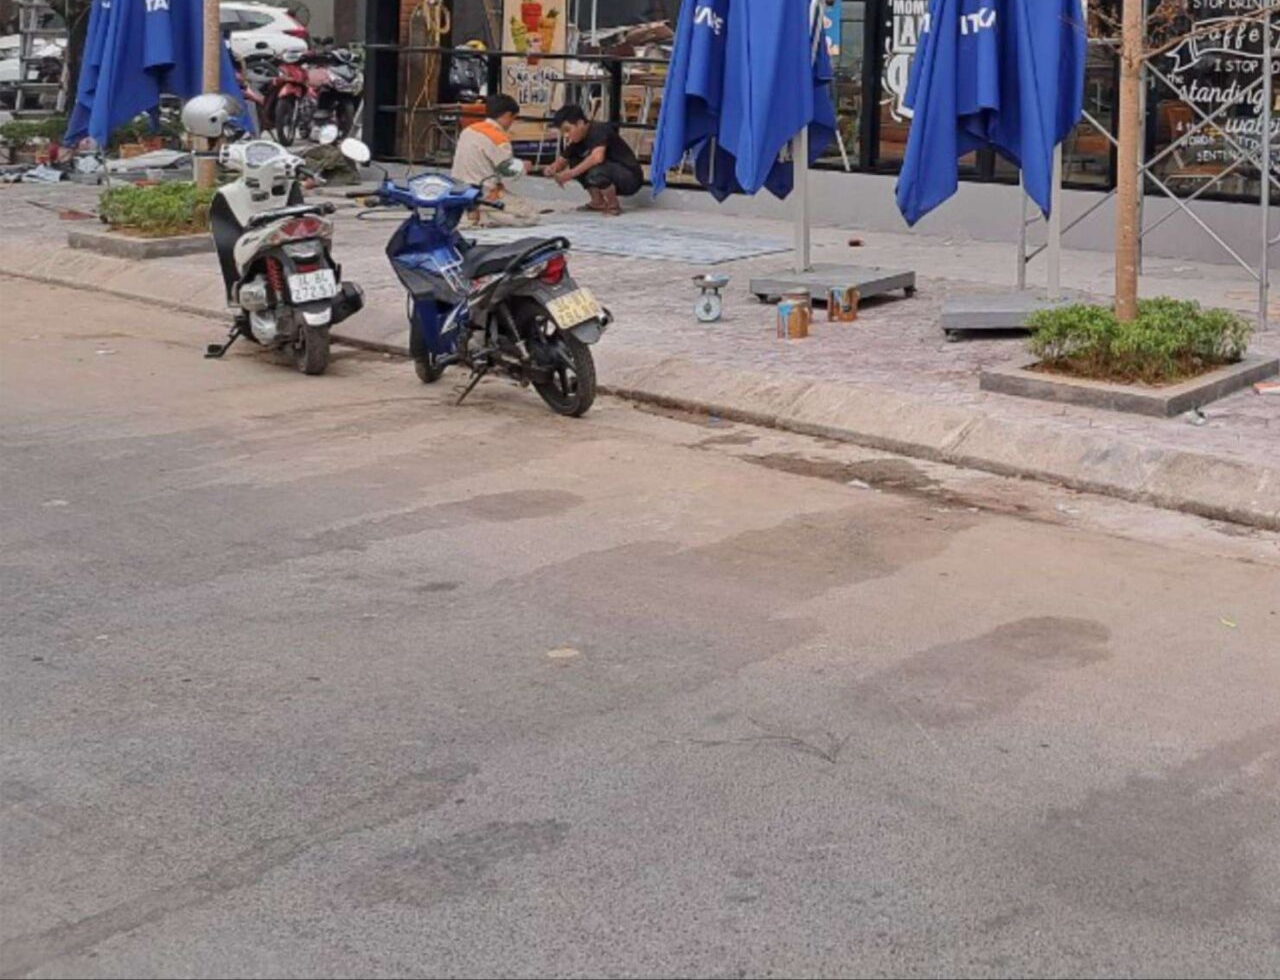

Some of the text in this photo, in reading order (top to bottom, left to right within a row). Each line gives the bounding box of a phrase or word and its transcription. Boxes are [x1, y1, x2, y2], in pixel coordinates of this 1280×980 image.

[893, 0, 928, 15] MOM
[1226, 60, 1259, 74] STOP
[1179, 79, 1266, 114] standing
